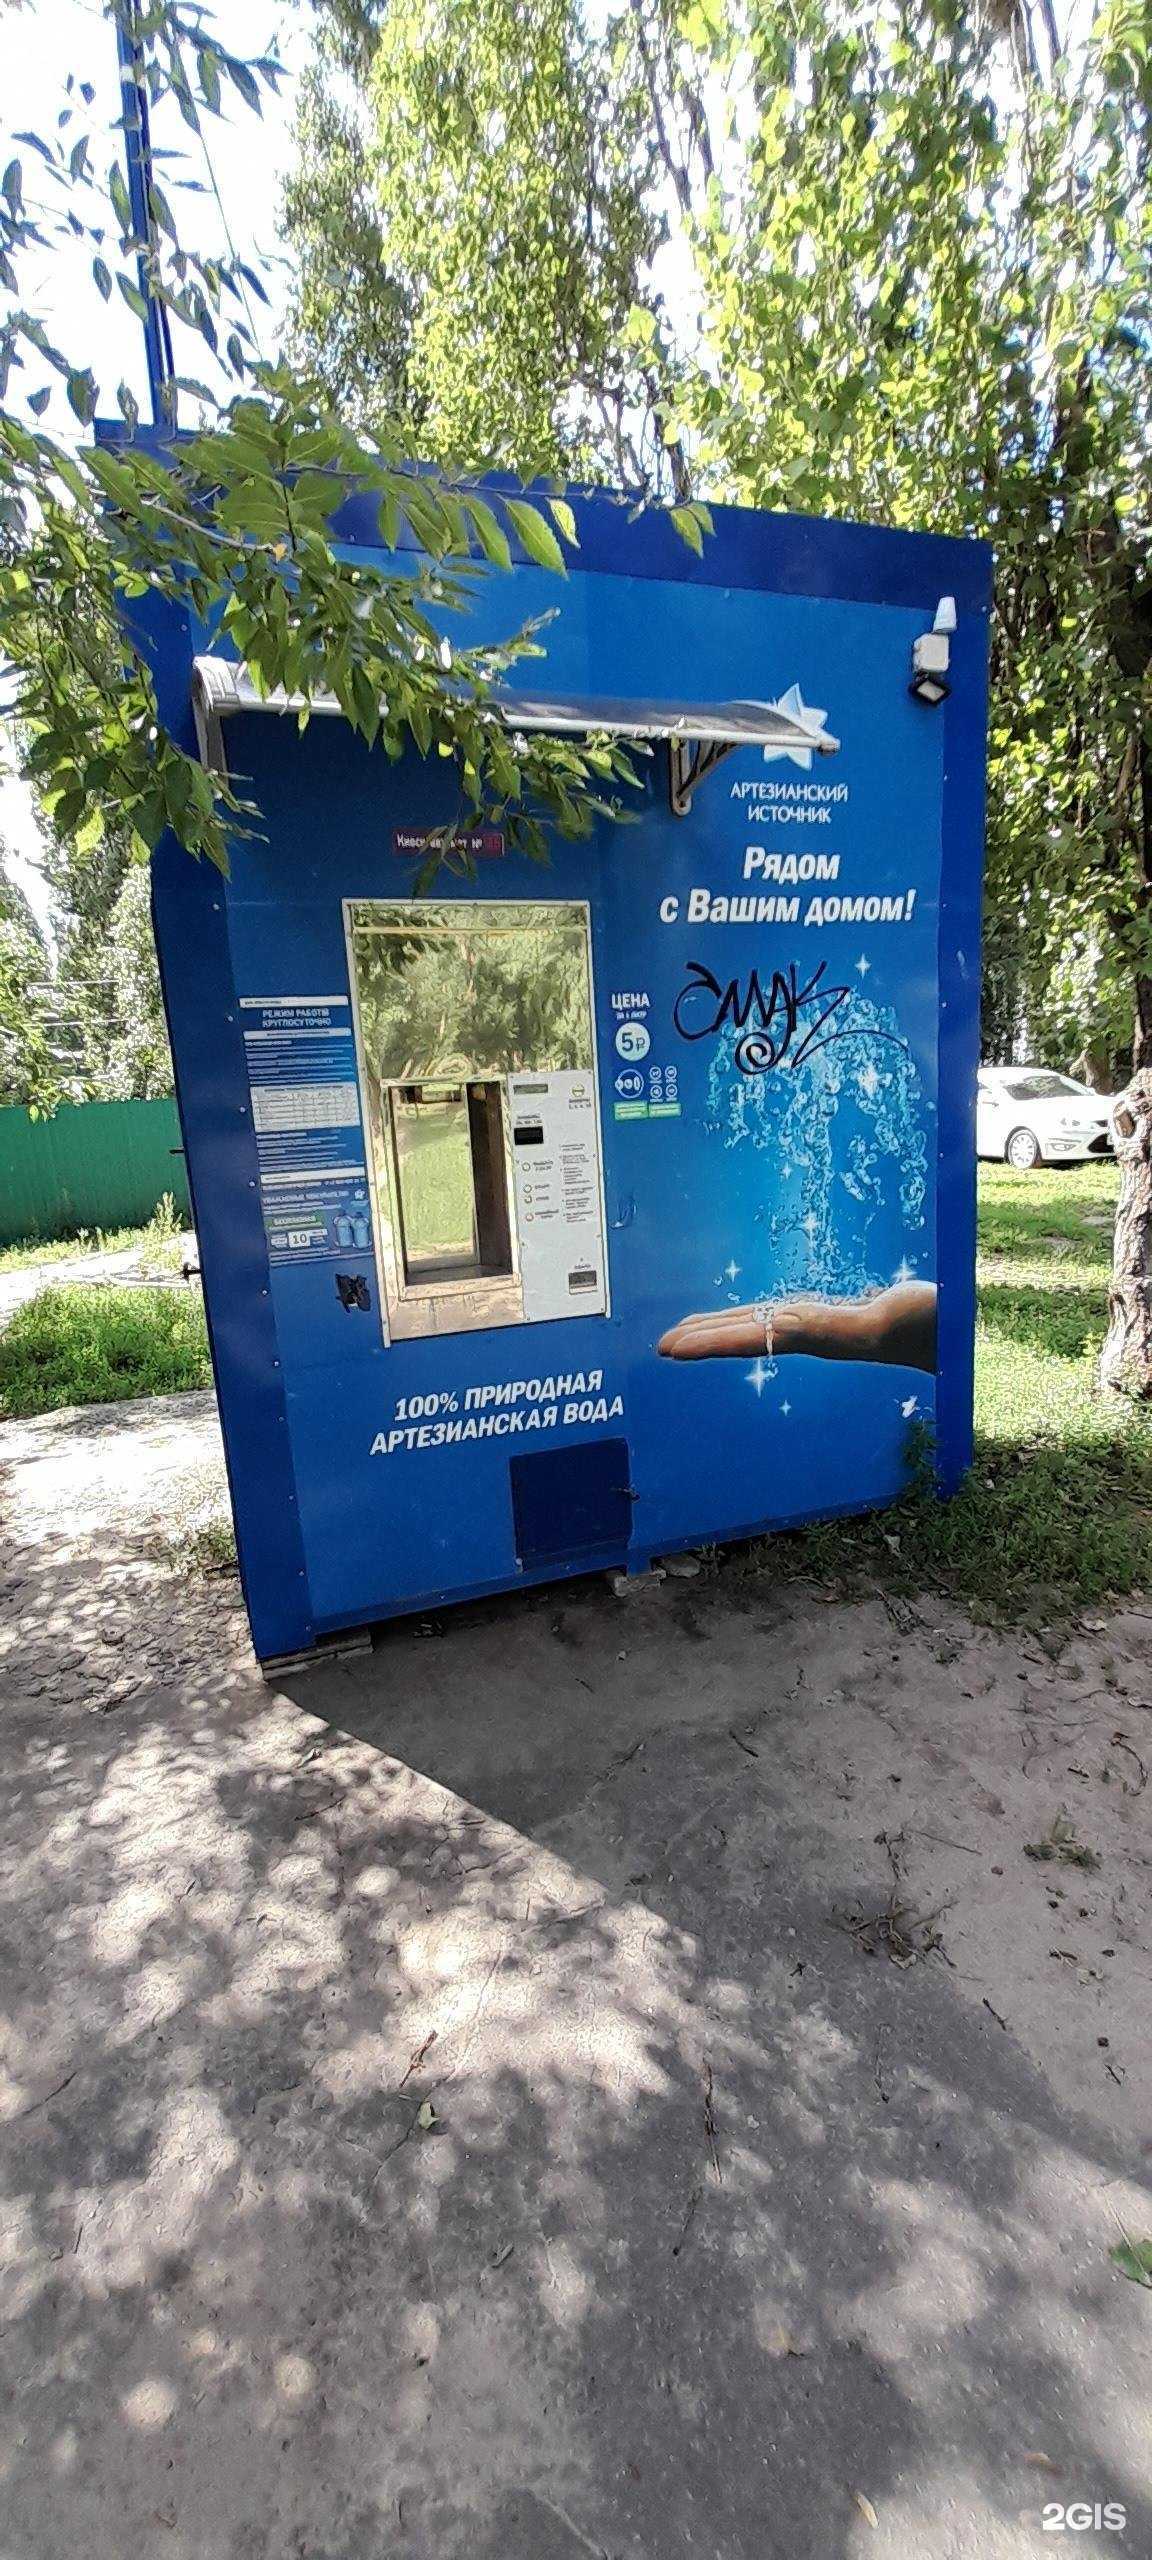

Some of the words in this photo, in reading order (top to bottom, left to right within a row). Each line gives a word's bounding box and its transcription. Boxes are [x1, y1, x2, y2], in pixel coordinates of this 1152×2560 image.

[731, 782, 849, 803] АРТЕЗИАНСКИЙ
[748, 805, 832, 824] ИСТОЧНИК
[743, 846, 841, 885] Рядом
[659, 896, 679, 923] с
[687, 888, 801, 923] Вашим
[804, 888, 917, 927] домом!
[611, 992, 650, 1010] ЦЕНА
[293, 1234, 307, 1244] 10
[394, 1391, 459, 1421] 100%
[464, 1369, 603, 1411] ПРИРОДНАЯ
[369, 1405, 558, 1455] АРТЕЗИАНСКАЯ
[563, 1395, 624, 1425] ВОДА
